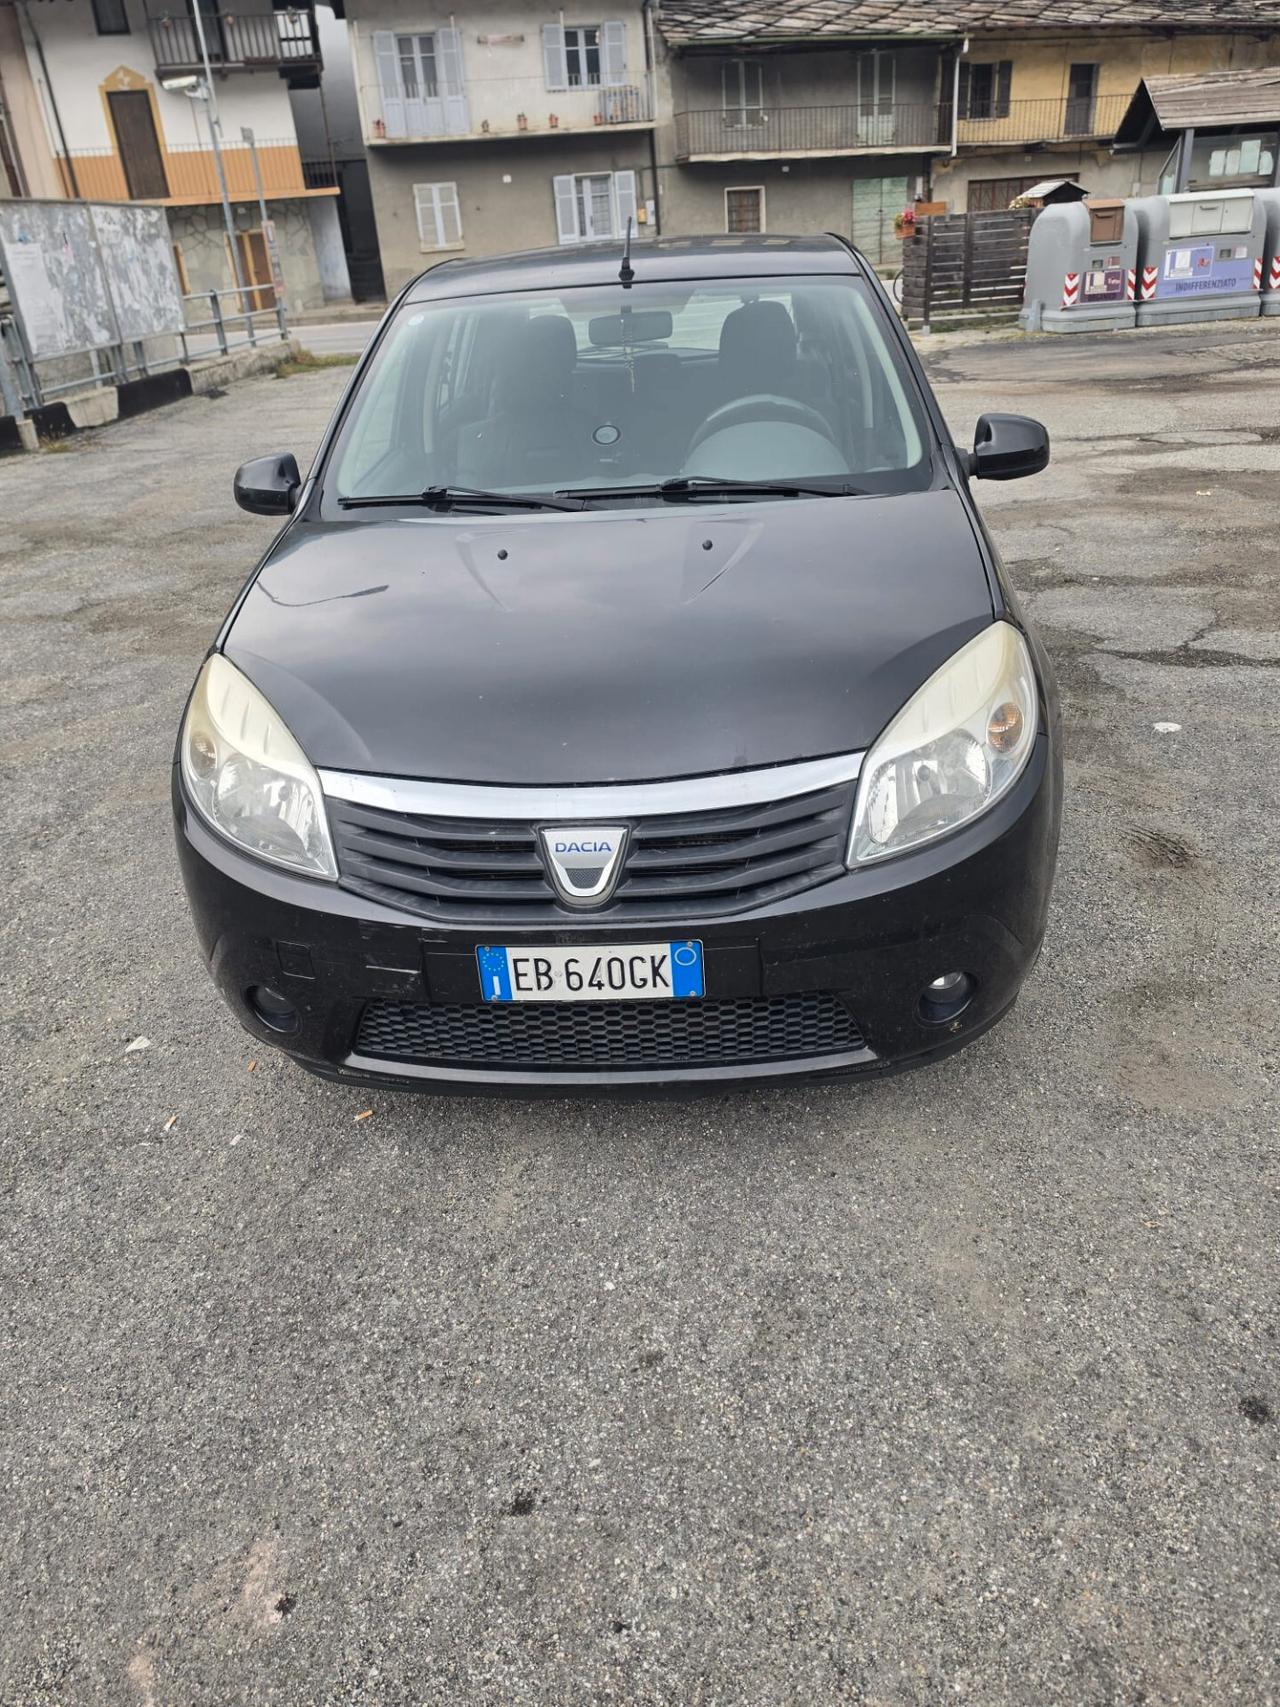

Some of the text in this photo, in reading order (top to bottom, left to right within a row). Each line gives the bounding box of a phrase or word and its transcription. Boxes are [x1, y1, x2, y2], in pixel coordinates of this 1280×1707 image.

[555, 841, 612, 852] DACIA
[512, 954, 670, 992] EB 640GK
